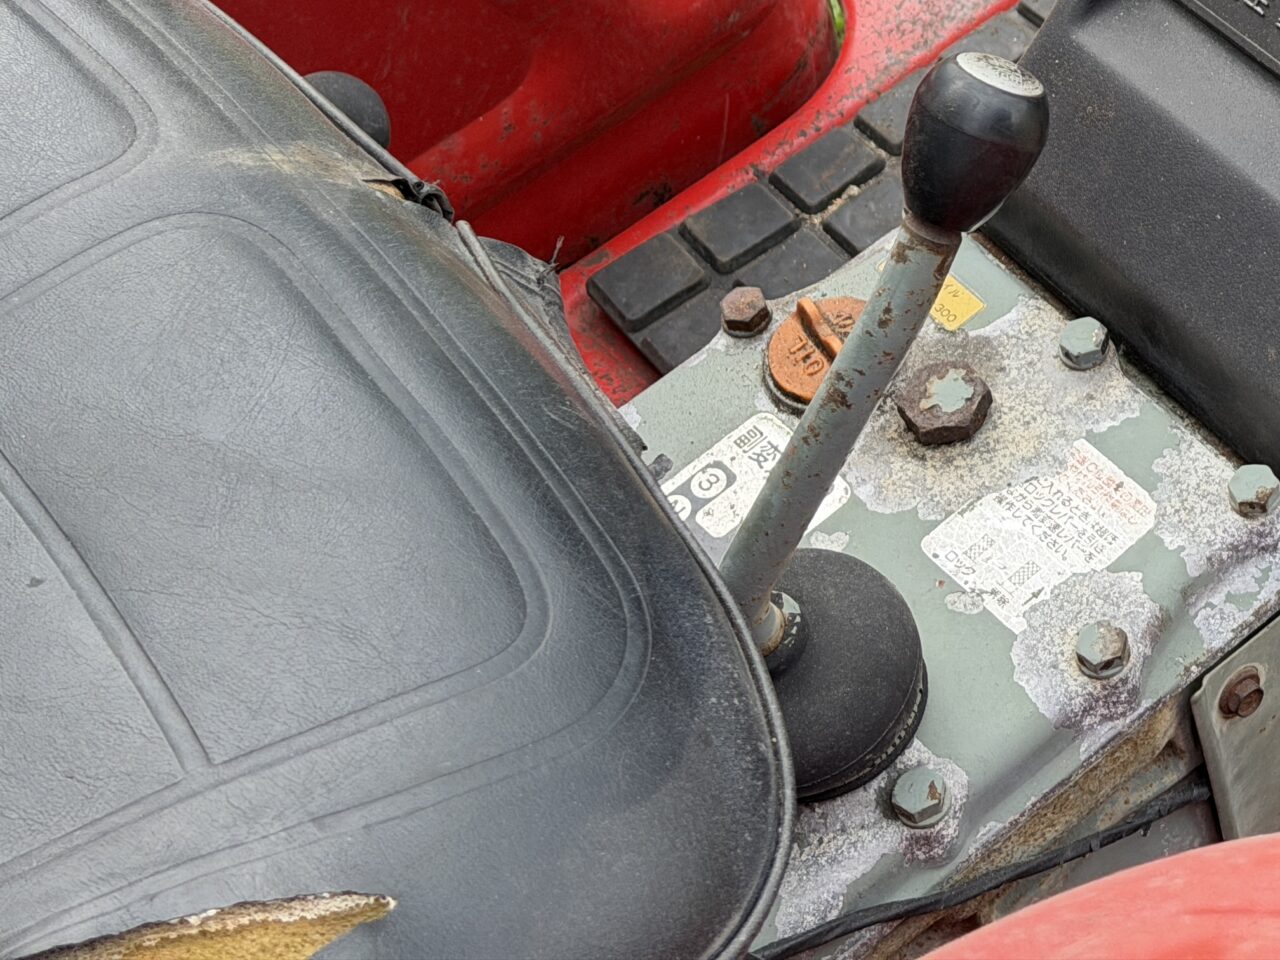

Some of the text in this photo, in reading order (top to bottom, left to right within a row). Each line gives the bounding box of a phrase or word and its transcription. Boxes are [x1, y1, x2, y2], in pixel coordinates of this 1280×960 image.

[934, 304, 958, 323] 300
[733, 425, 783, 472] 副変
[698, 473, 720, 492] 3
